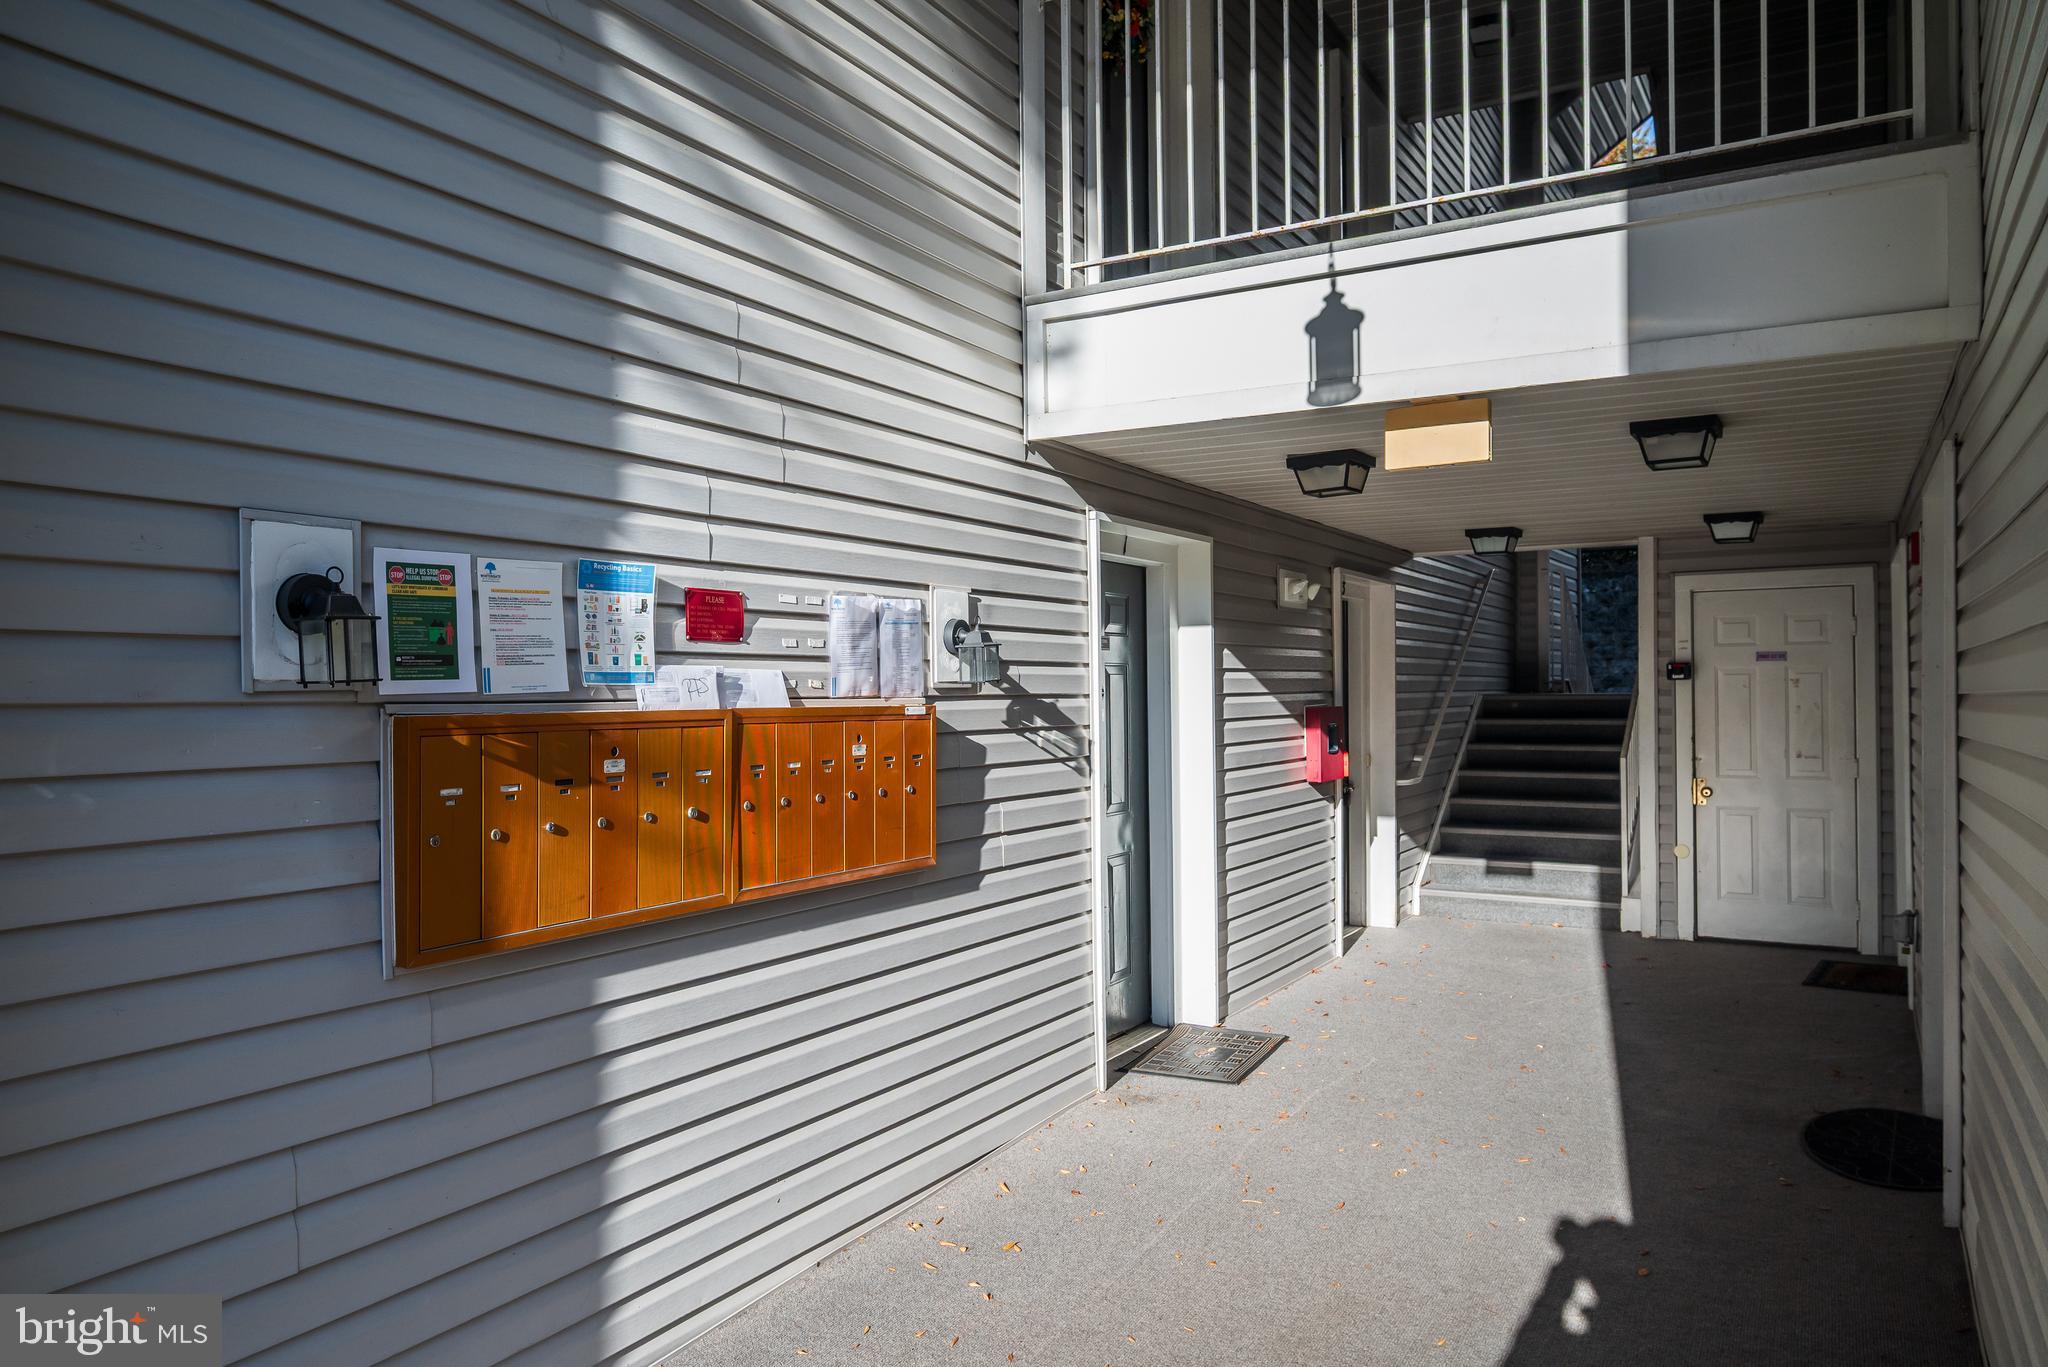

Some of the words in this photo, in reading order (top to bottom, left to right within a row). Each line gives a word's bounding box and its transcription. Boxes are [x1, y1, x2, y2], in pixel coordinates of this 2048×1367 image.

[593, 562, 622, 572] Recycling
[622, 565, 642, 573] Basics
[705, 595, 725, 604] PLEASE
